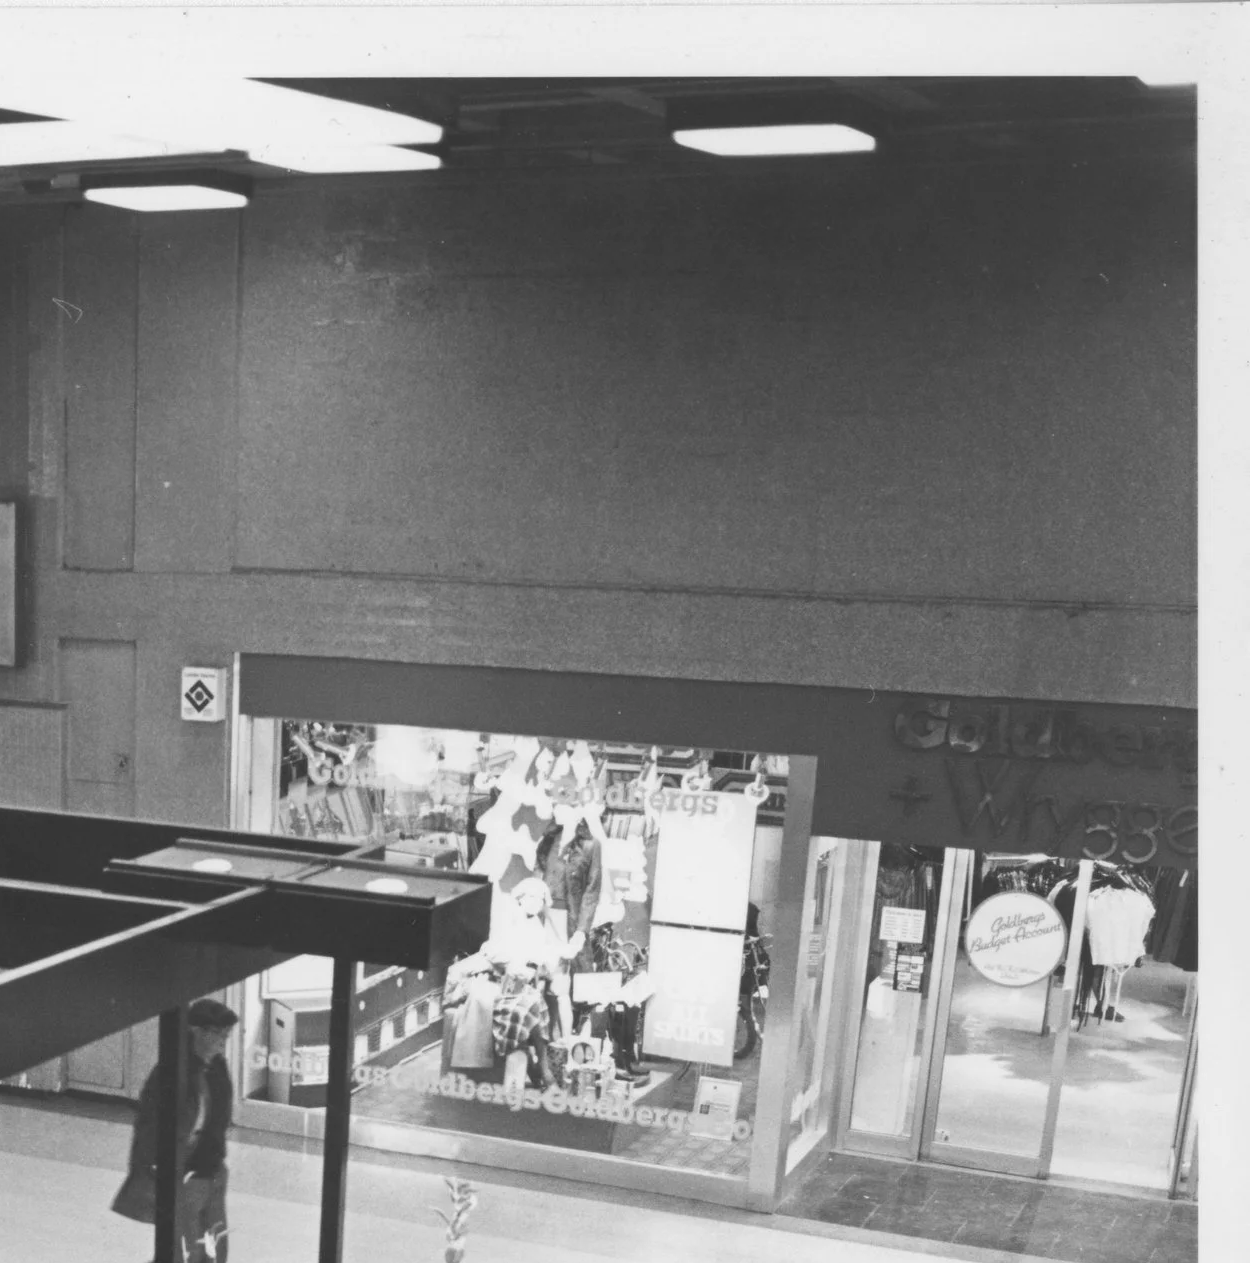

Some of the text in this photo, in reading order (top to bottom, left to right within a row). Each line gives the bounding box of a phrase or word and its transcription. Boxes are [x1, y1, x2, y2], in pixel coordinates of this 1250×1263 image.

[969, 923, 1062, 954] Budget Account
[991, 912, 1046, 937] Goldbergs
